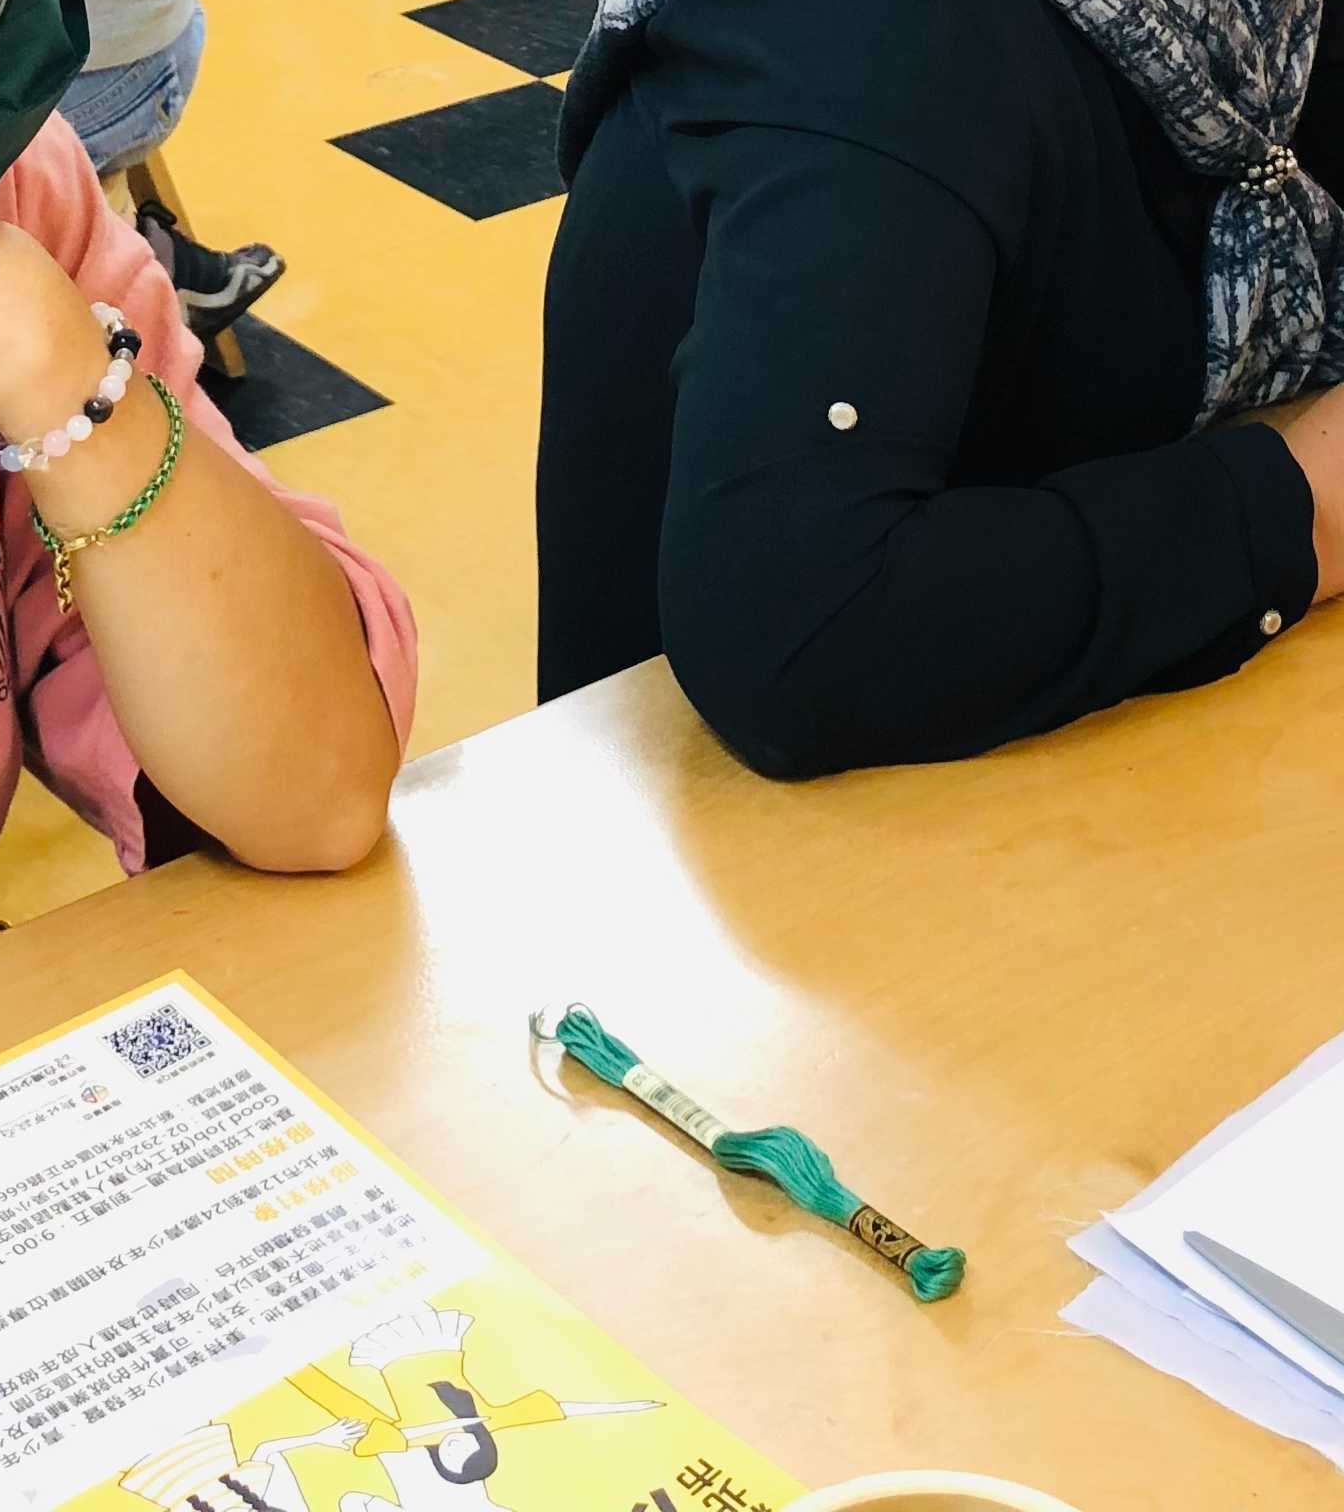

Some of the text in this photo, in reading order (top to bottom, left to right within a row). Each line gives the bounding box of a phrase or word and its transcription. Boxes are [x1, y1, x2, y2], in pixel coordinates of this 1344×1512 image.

[227, 1091, 279, 1127] Good
[204, 1117, 315, 1188] 服務時間
